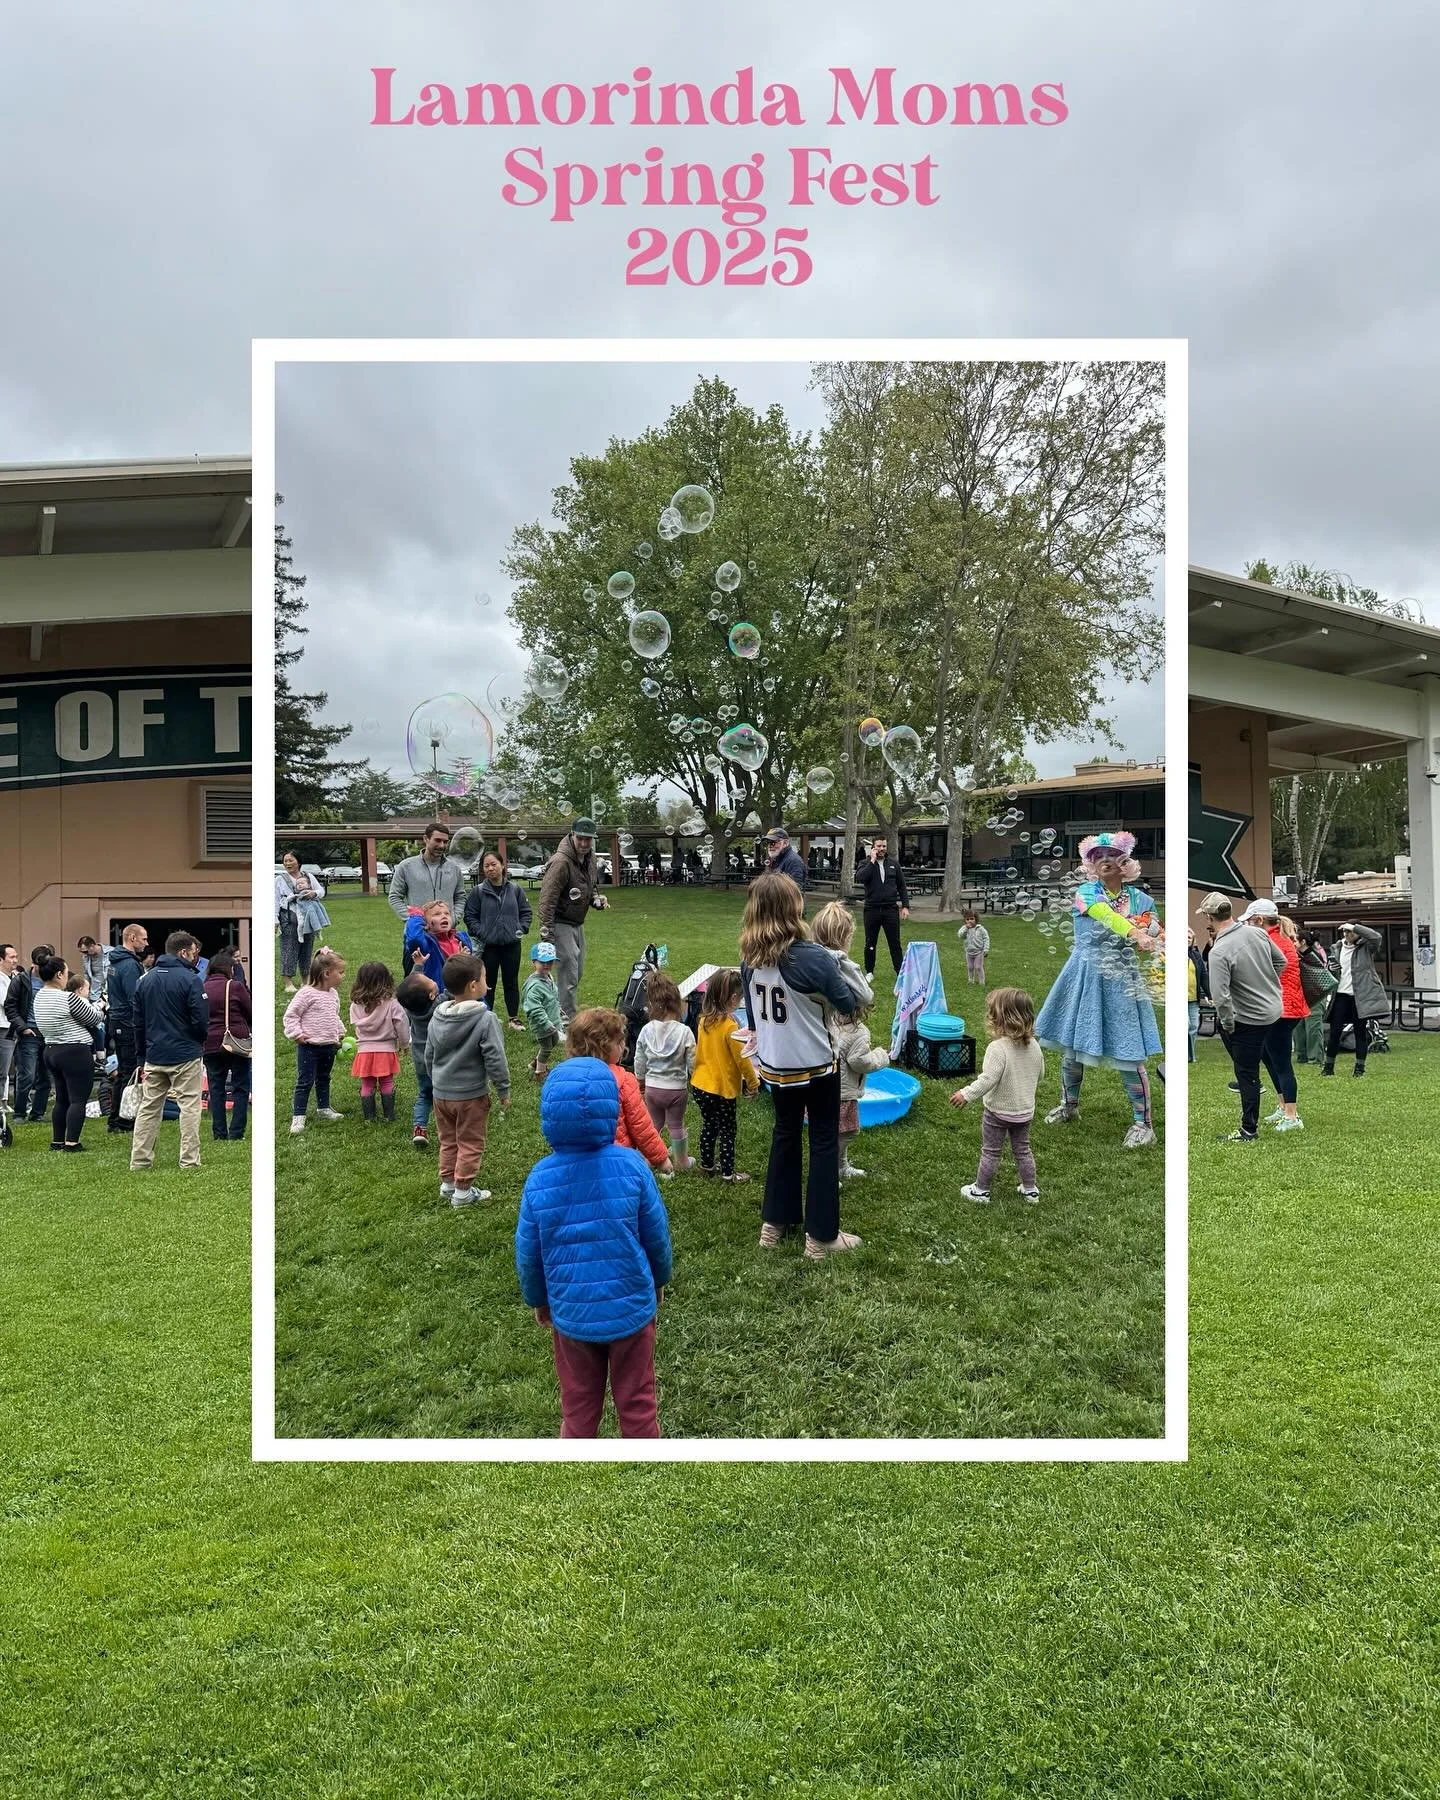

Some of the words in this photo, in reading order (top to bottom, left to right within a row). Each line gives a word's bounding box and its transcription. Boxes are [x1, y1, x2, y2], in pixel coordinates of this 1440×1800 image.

[55, 689, 165, 762] OF
[199, 686, 252, 753] T
[755, 983, 788, 1024] 76
